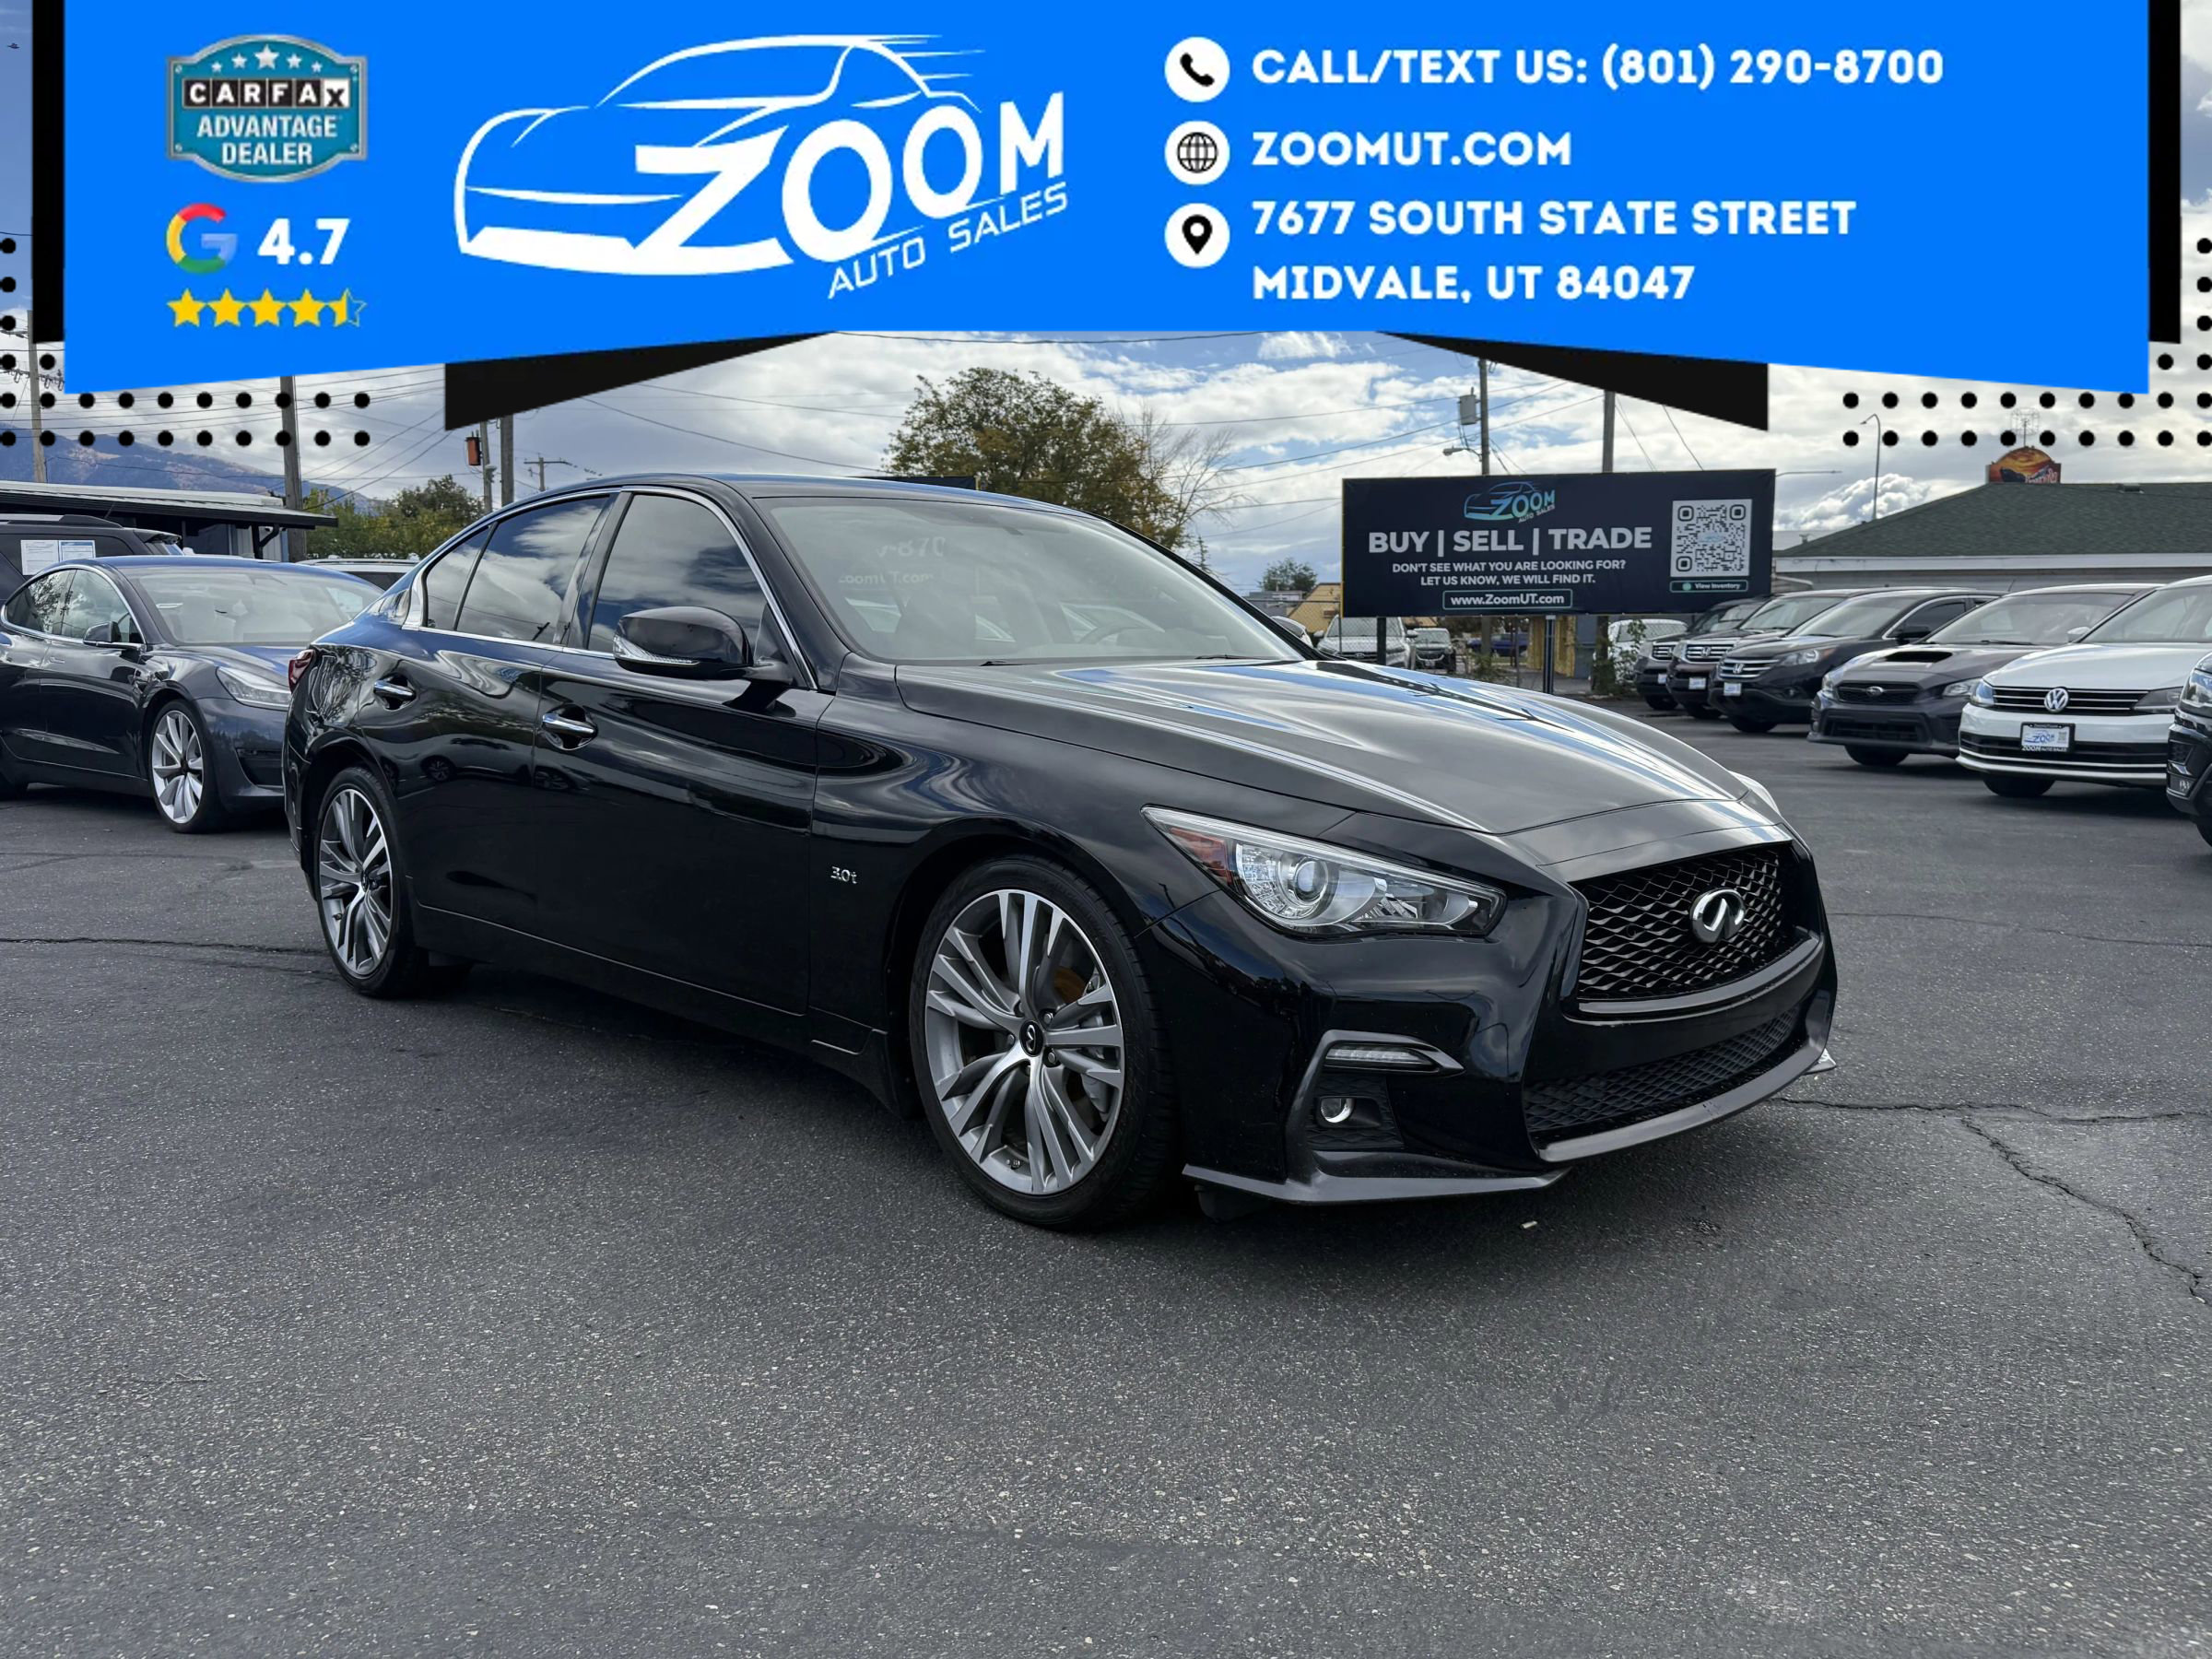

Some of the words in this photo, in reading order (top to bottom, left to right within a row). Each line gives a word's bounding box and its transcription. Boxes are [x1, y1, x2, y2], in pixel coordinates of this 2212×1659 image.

[1490, 489, 1555, 519] ZOOM
[1518, 512, 1535, 524] AUTO
[1535, 503, 1556, 516] SALES
[1369, 531, 1430, 553] BUY
[1453, 529, 1524, 552] SELL
[1547, 526, 1653, 550] TRADE
[1392, 562, 1428, 573] DON'T
[1430, 562, 1451, 572] SEE
[1453, 561, 1487, 572] WHAT
[1488, 561, 1512, 571] YOU
[1514, 560, 1538, 571] ARE
[1540, 560, 1594, 571] LOOKING
[1595, 559, 1627, 570] FOR?
[1420, 576, 1441, 586] LET
[1442, 576, 1458, 585] US
[1460, 575, 1500, 585] KNOW,
[1501, 575, 1521, 584] WE
[1523, 574, 1550, 584] WILL
[1552, 574, 1581, 583] FIND
[1583, 573, 1596, 583] IT.
[1712, 582, 1741, 591] Inventory
[1450, 593, 1565, 606] www.ZoomUT.com
[830, 865, 857, 885] 3.0t
